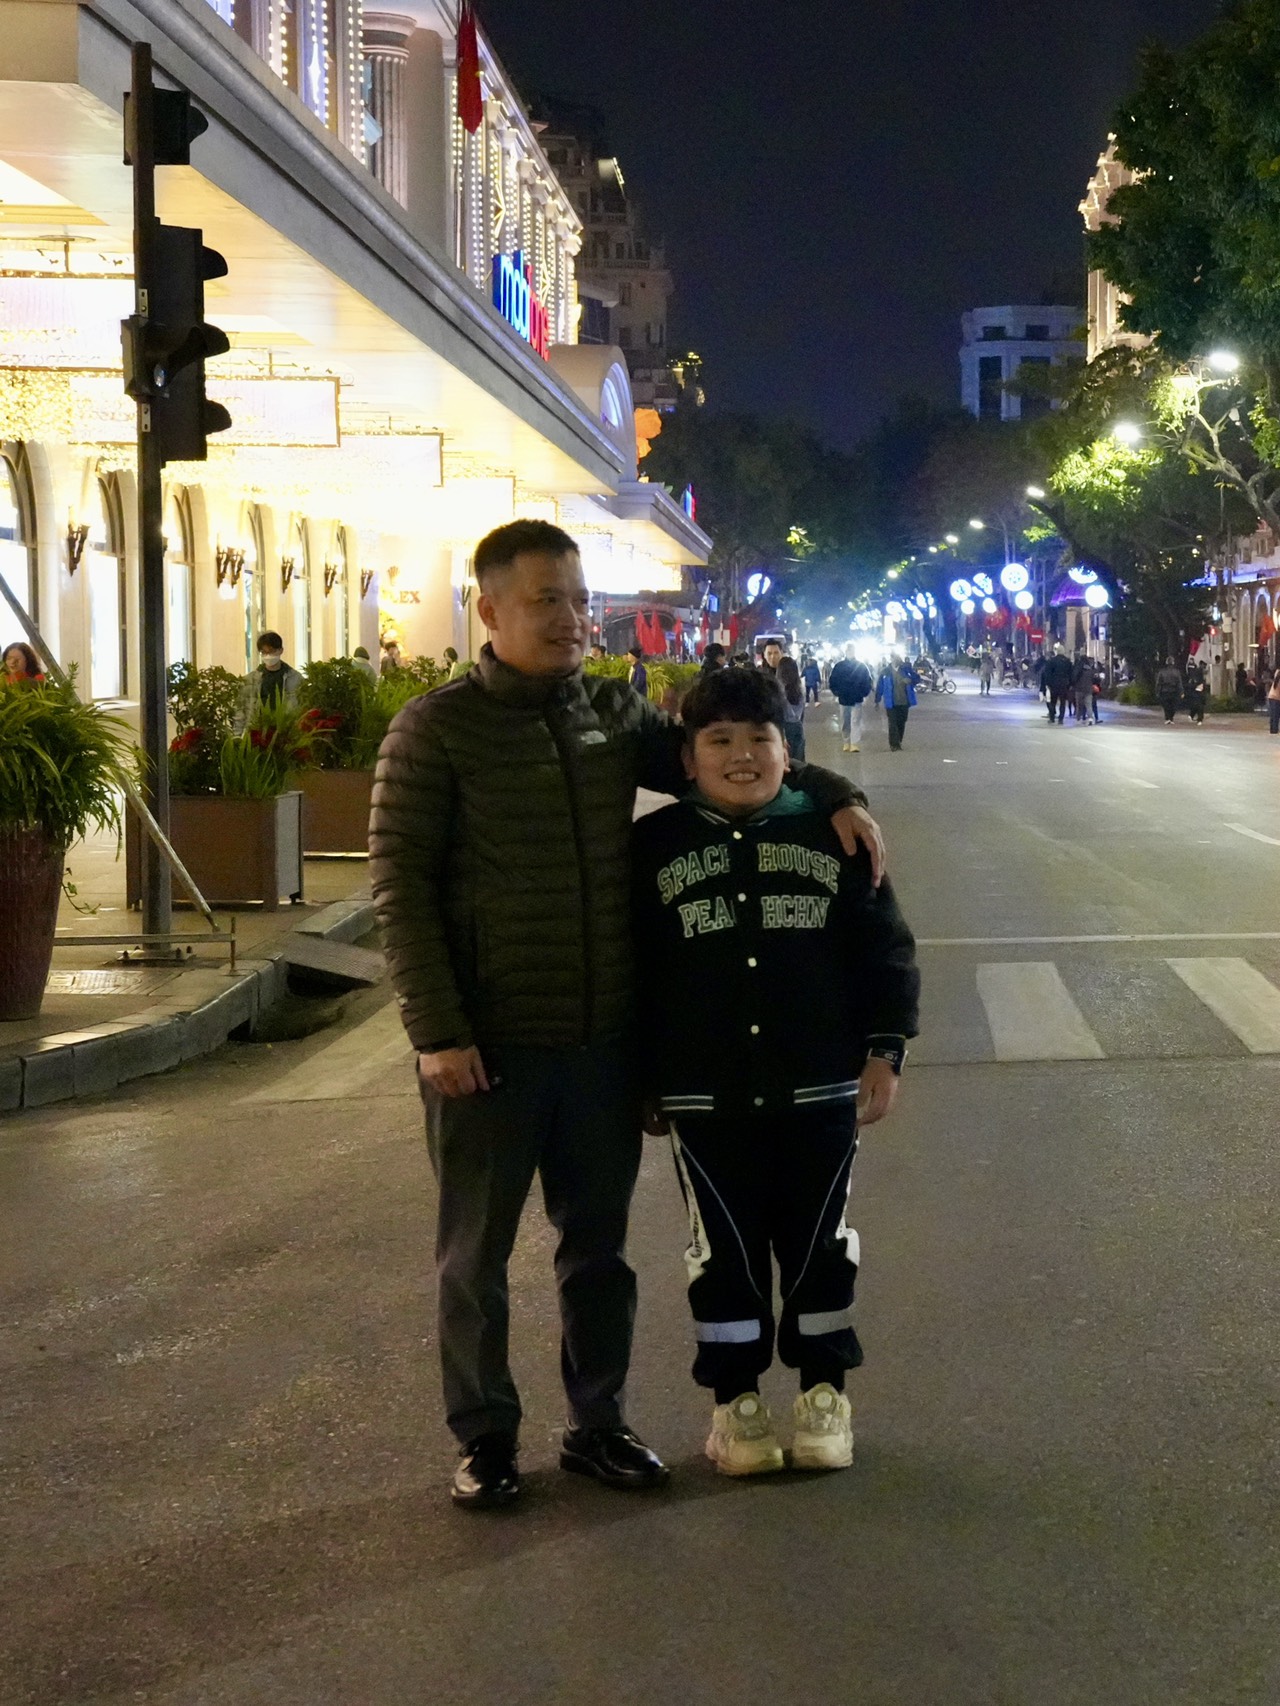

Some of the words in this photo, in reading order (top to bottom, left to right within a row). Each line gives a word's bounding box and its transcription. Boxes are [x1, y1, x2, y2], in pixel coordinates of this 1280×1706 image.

[757, 843, 841, 894] HOUSE
[677, 896, 737, 938] PEA
[761, 895, 830, 928] HCHN
